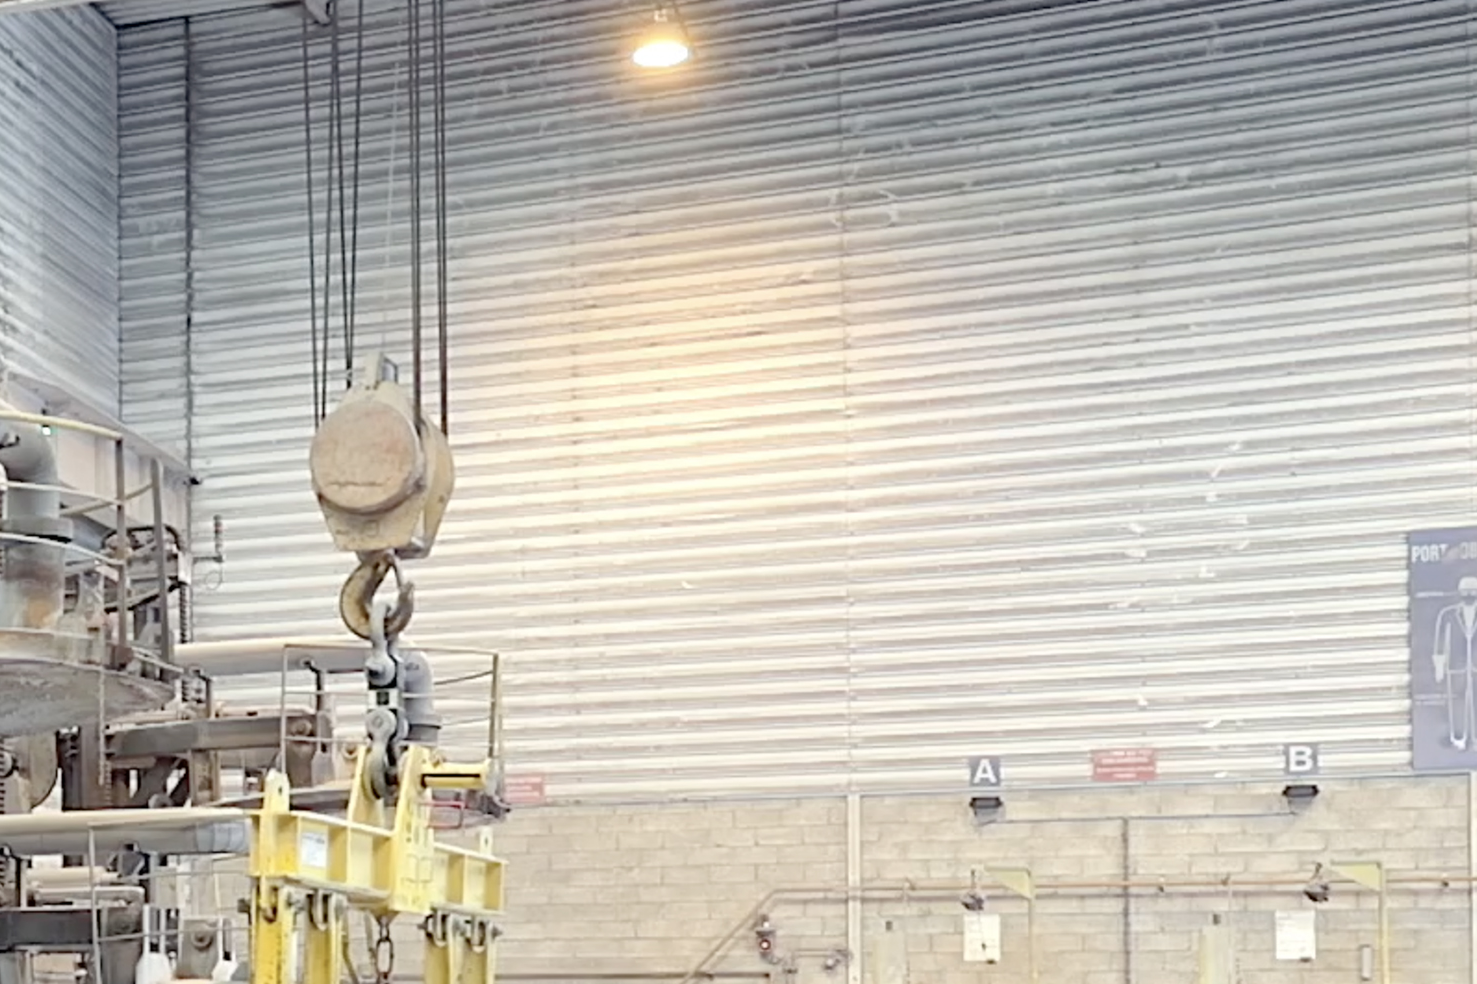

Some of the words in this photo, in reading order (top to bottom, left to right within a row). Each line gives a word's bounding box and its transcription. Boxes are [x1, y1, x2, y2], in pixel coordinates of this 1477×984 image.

[1411, 544, 1449, 563] PORT
[974, 758, 998, 783] A
[1289, 745, 1313, 771] B
